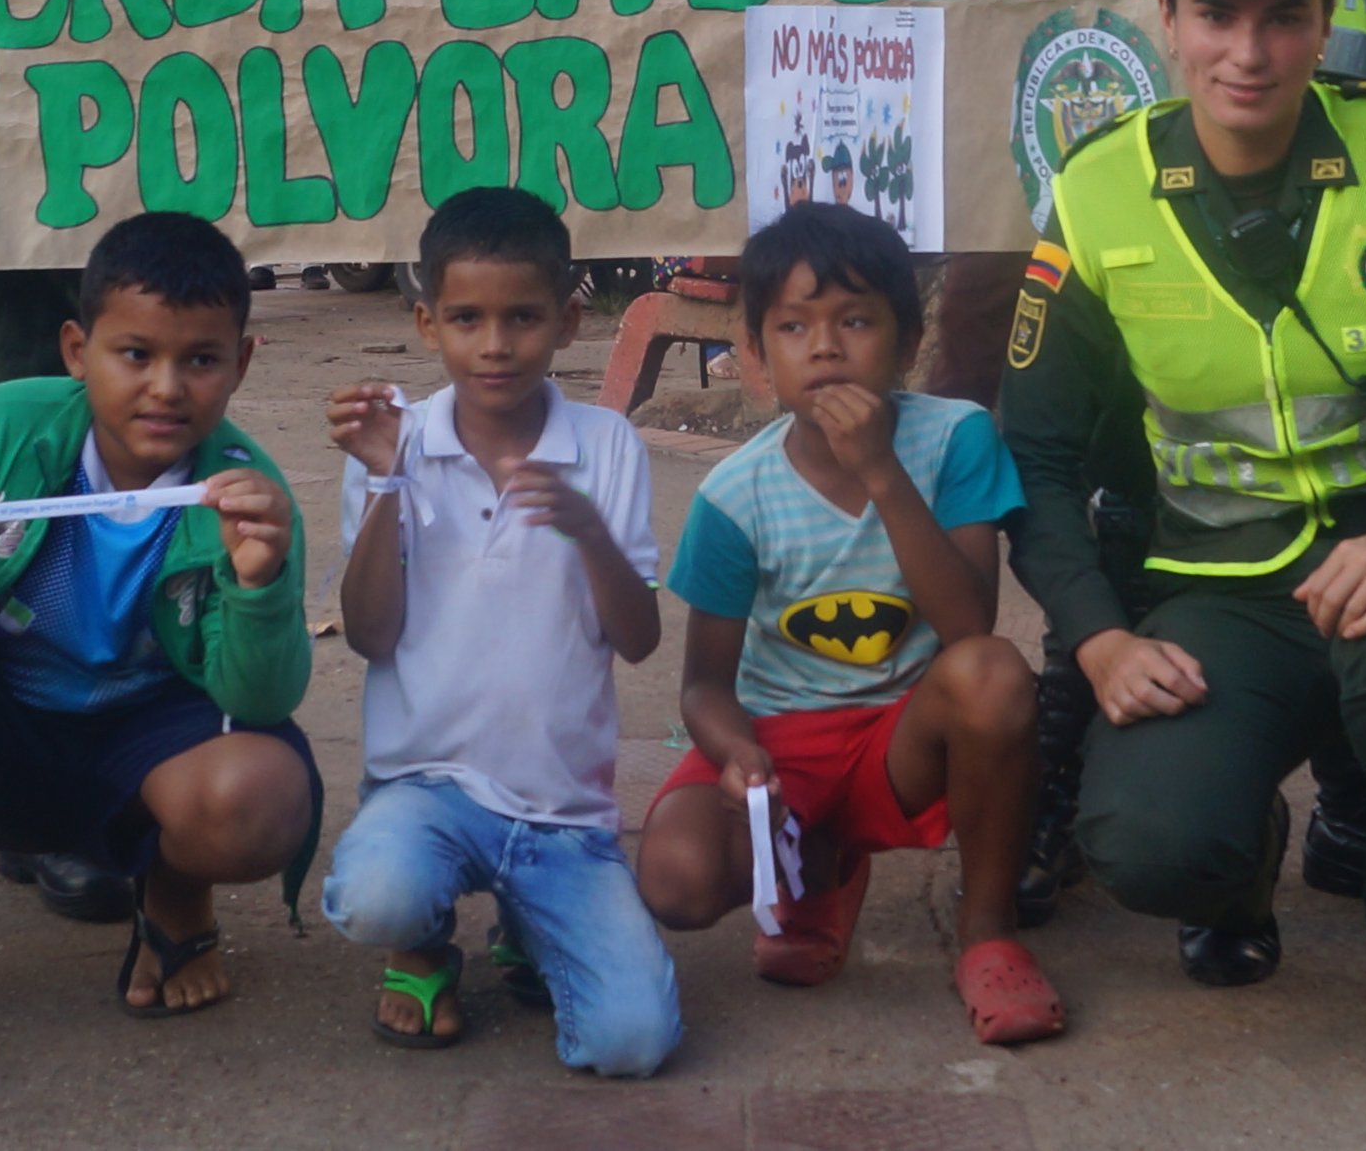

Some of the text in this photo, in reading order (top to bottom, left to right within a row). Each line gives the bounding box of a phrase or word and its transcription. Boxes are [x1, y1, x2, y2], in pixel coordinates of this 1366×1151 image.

[771, 16, 915, 85] NO MÁS PÓLVORA
[1024, 41, 1064, 135] REPUBLICA
[1077, 32, 1097, 45] DE
[24, 32, 736, 229] POLVORA
